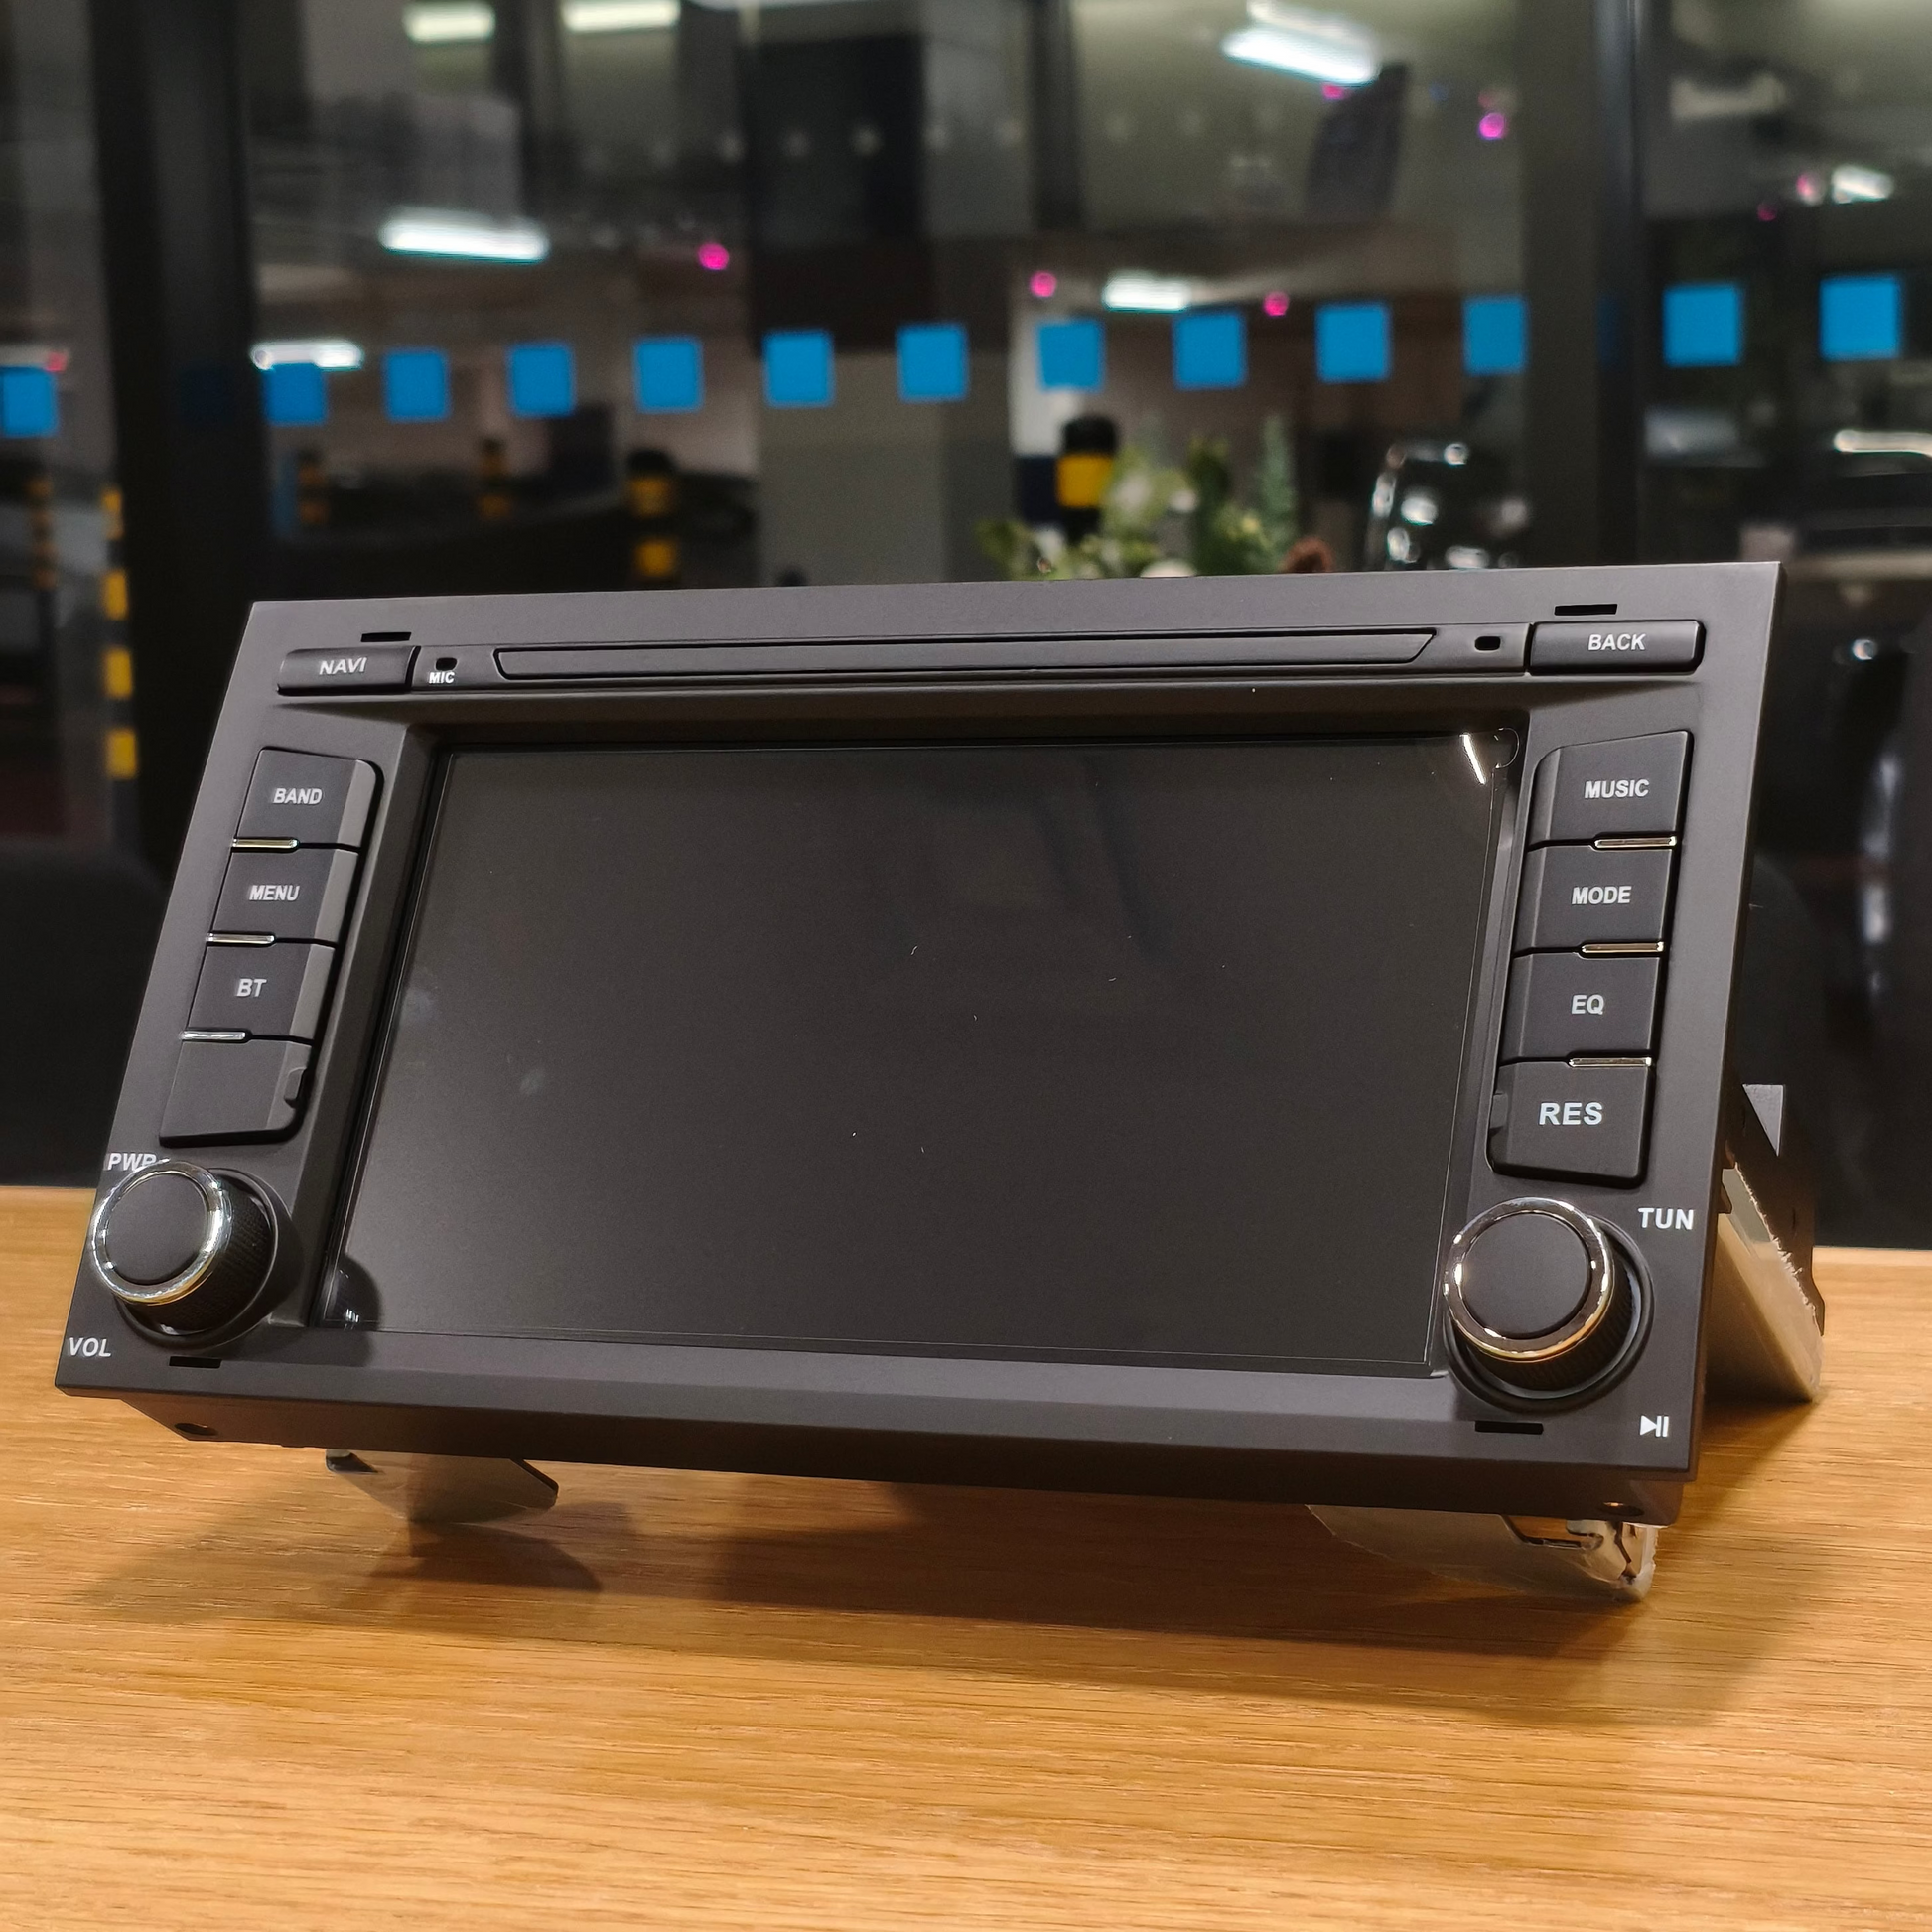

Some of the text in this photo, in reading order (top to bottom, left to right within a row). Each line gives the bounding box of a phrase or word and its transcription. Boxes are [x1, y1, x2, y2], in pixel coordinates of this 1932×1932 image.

[1588, 633, 1646, 651] BACK
[319, 656, 367, 675] NAVI
[428, 670, 456, 684] MIC
[272, 787, 323, 805] BAND
[1584, 778, 1650, 799] MUSIC
[248, 884, 300, 901] MENU
[1571, 885, 1632, 905] MODE
[235, 978, 267, 997] BT
[1571, 994, 1605, 1016] EQ
[1539, 1101, 1603, 1126] RES
[1637, 1207, 1695, 1231] TUN
[68, 1337, 112, 1357] VOL
